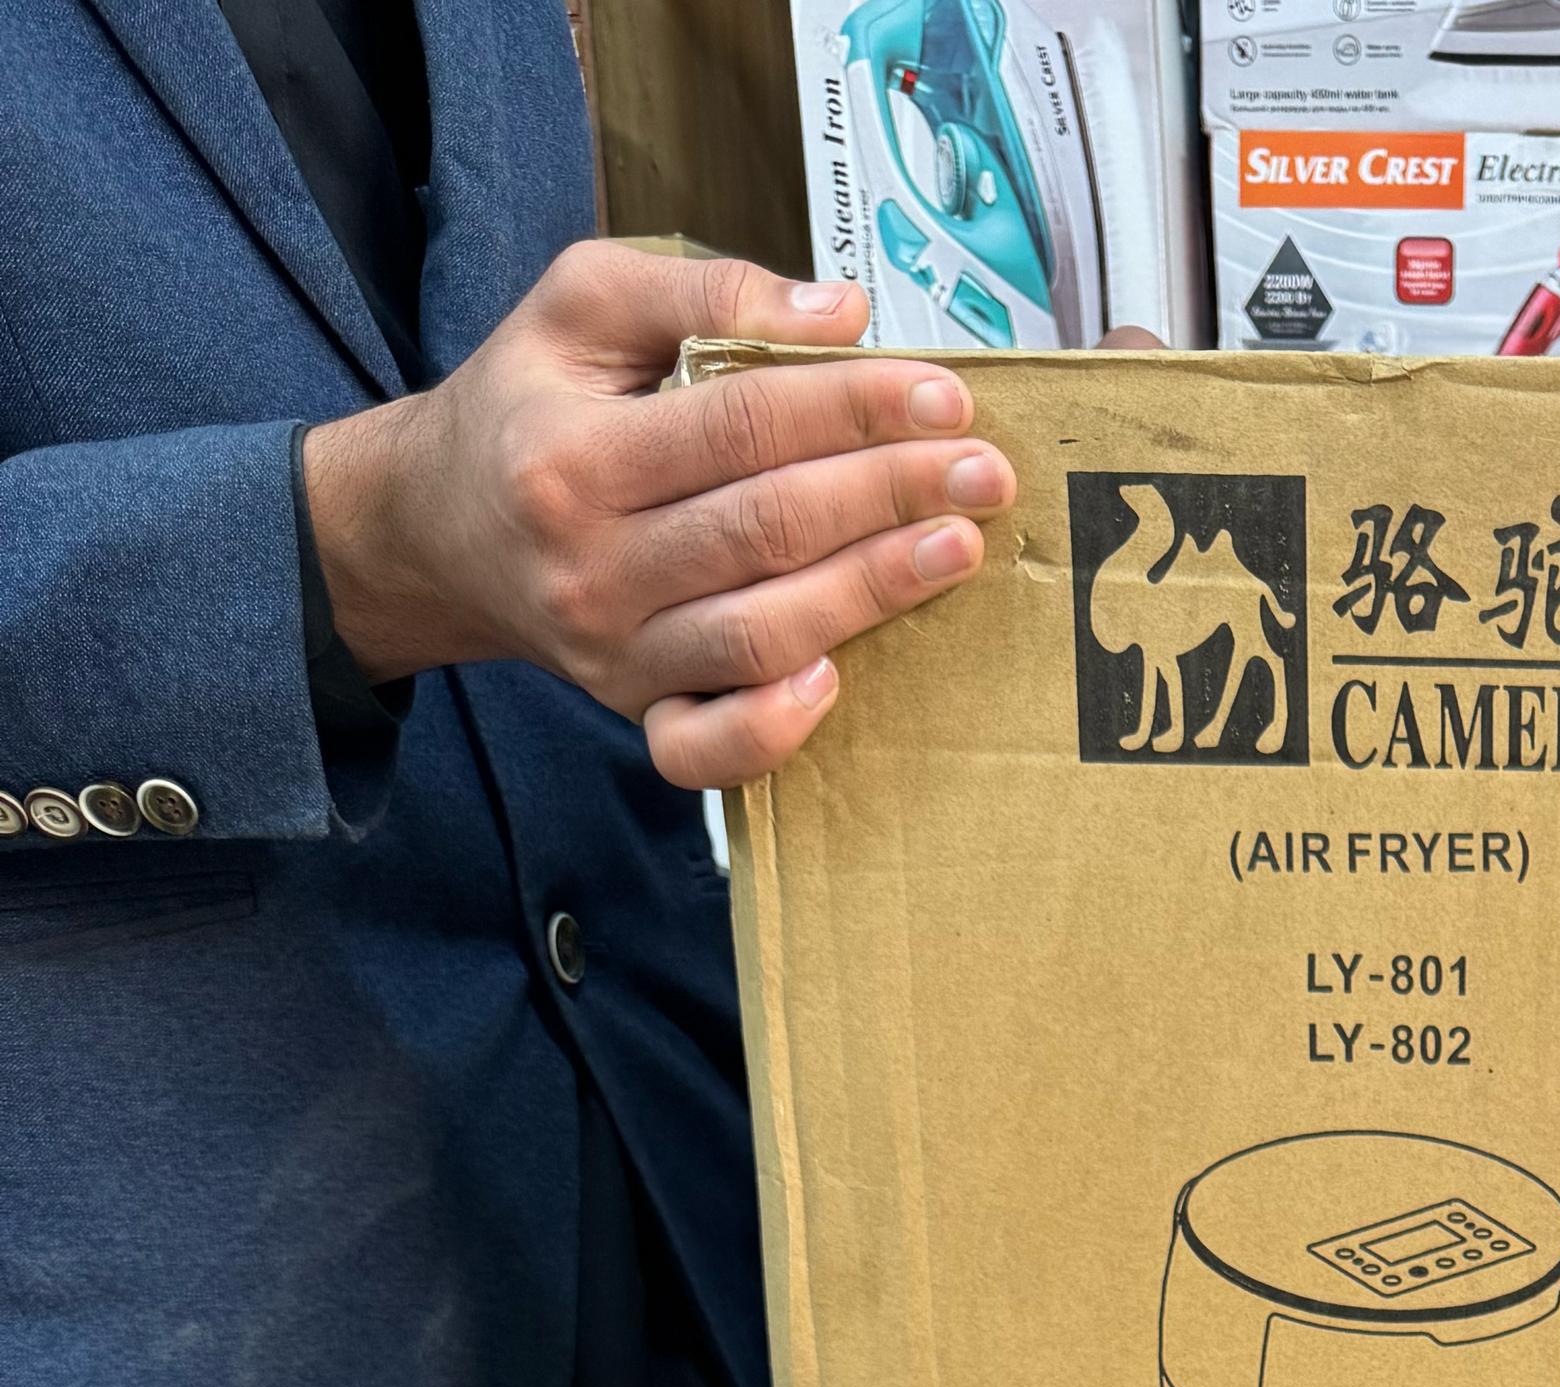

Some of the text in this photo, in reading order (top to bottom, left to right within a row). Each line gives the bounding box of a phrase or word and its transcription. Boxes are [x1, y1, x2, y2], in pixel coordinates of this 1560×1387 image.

[824, 78, 857, 257] Steam Iron
[1246, 148, 1458, 187] SILVER CREST
[1229, 830, 1530, 883] (AIR FRYER)
[1307, 953, 1468, 996] LY-801
[1308, 1023, 1472, 1065] LY-802
